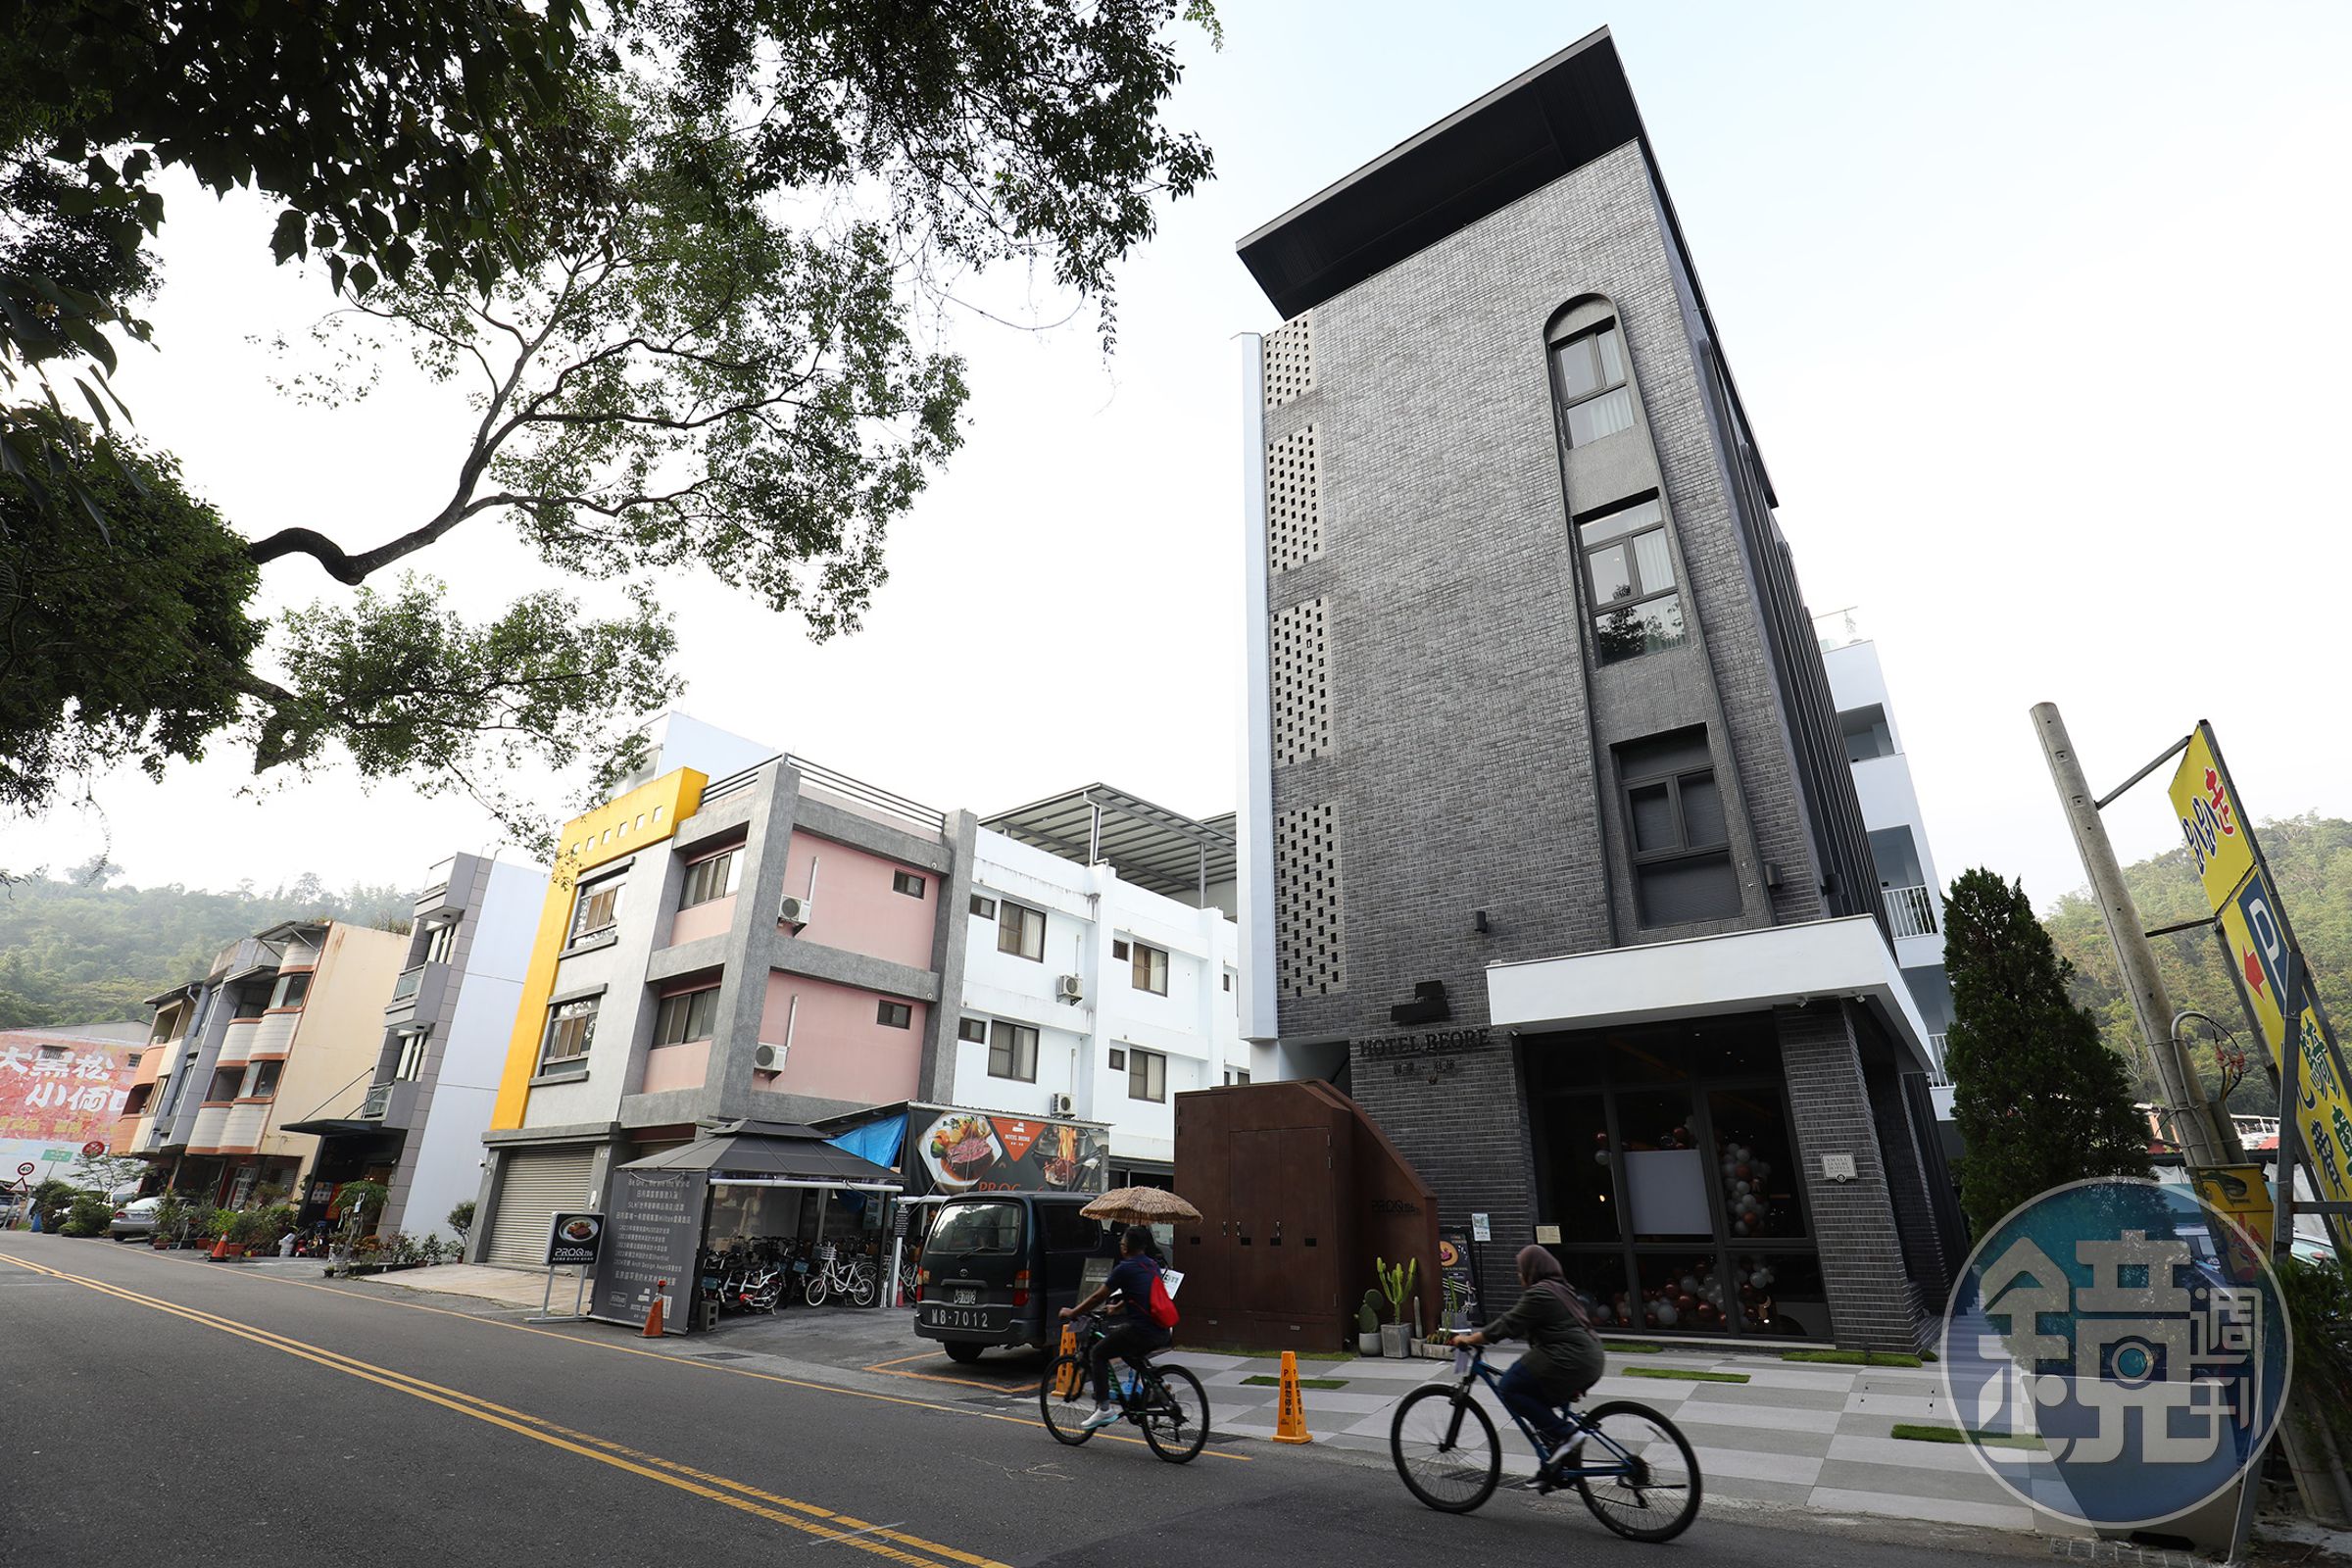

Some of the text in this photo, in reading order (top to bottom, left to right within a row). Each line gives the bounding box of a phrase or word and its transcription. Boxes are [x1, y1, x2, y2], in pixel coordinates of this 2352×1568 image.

[2249, 899, 2287, 1004] P
[0, 1046, 116, 1081] 大黑松
[1359, 1035, 1421, 1057] HOTEL
